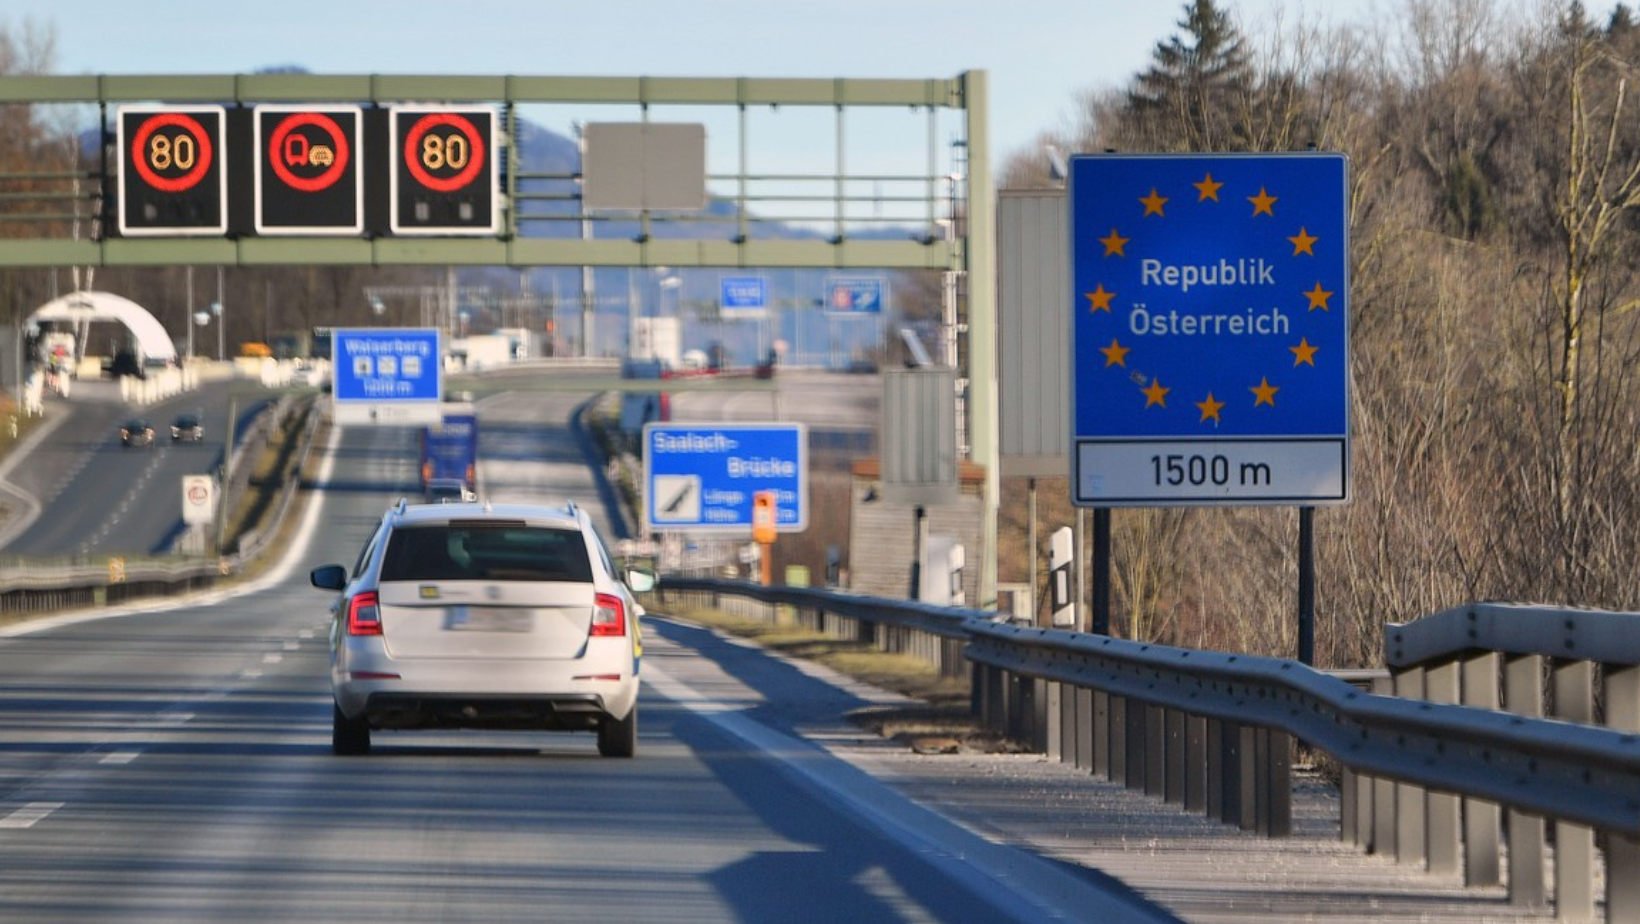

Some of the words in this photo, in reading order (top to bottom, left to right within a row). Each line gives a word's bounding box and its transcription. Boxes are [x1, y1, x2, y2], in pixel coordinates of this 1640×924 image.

[150, 133, 194, 170] 80
[423, 133, 468, 170] 80
[1141, 258, 1275, 291] Republik
[1129, 303, 1290, 335] Österreich
[344, 338, 430, 358] Walserberg
[653, 431, 738, 453] Saalach-
[727, 456, 796, 478] Brücke
[1151, 454, 1229, 486] 1500
[1239, 462, 1271, 486] m
